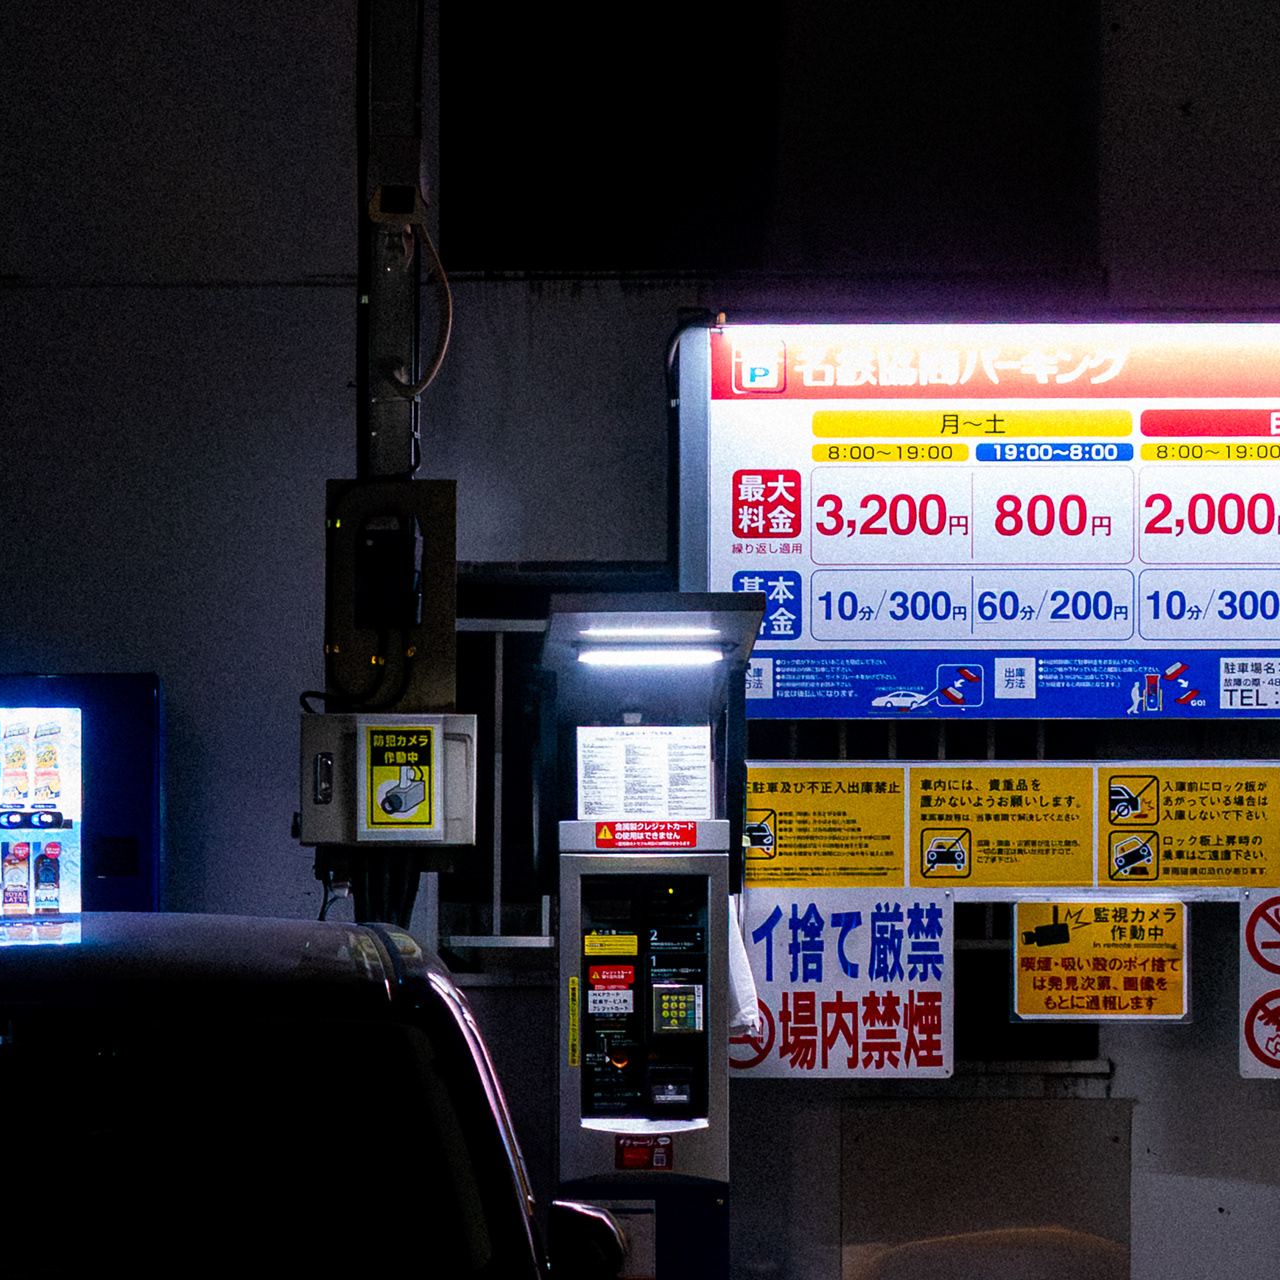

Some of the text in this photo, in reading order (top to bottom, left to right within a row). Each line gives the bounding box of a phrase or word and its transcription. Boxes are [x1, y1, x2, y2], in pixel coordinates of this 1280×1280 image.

[738, 475, 796, 503] 最大
[738, 505, 796, 533] 料金
[816, 493, 969, 538] 3,200円
[994, 493, 1112, 537] 800円
[757, 607, 797, 636] 金
[1004, 667, 1026, 678] 出庫
[1004, 678, 1026, 689] 方法
[373, 734, 429, 747] 防犯カメラ
[384, 751, 419, 764] 作動中
[1162, 781, 1267, 792] 入庫前にロック板が
[1162, 795, 1268, 806] あがっている場合は
[614, 831, 681, 840] の使用はできません
[1162, 835, 1263, 846] ロック板上昇時の
[1093, 907, 1177, 923] 監視カメラ
[649, 930, 658, 941] 2
[1110, 925, 1164, 941] 作動中
[650, 955, 657, 966] 1
[1032, 976, 1168, 991] は発見次第、画像を
[1044, 995, 1158, 1011] もとに通報します
[778, 989, 944, 1070] 場内禁煙
